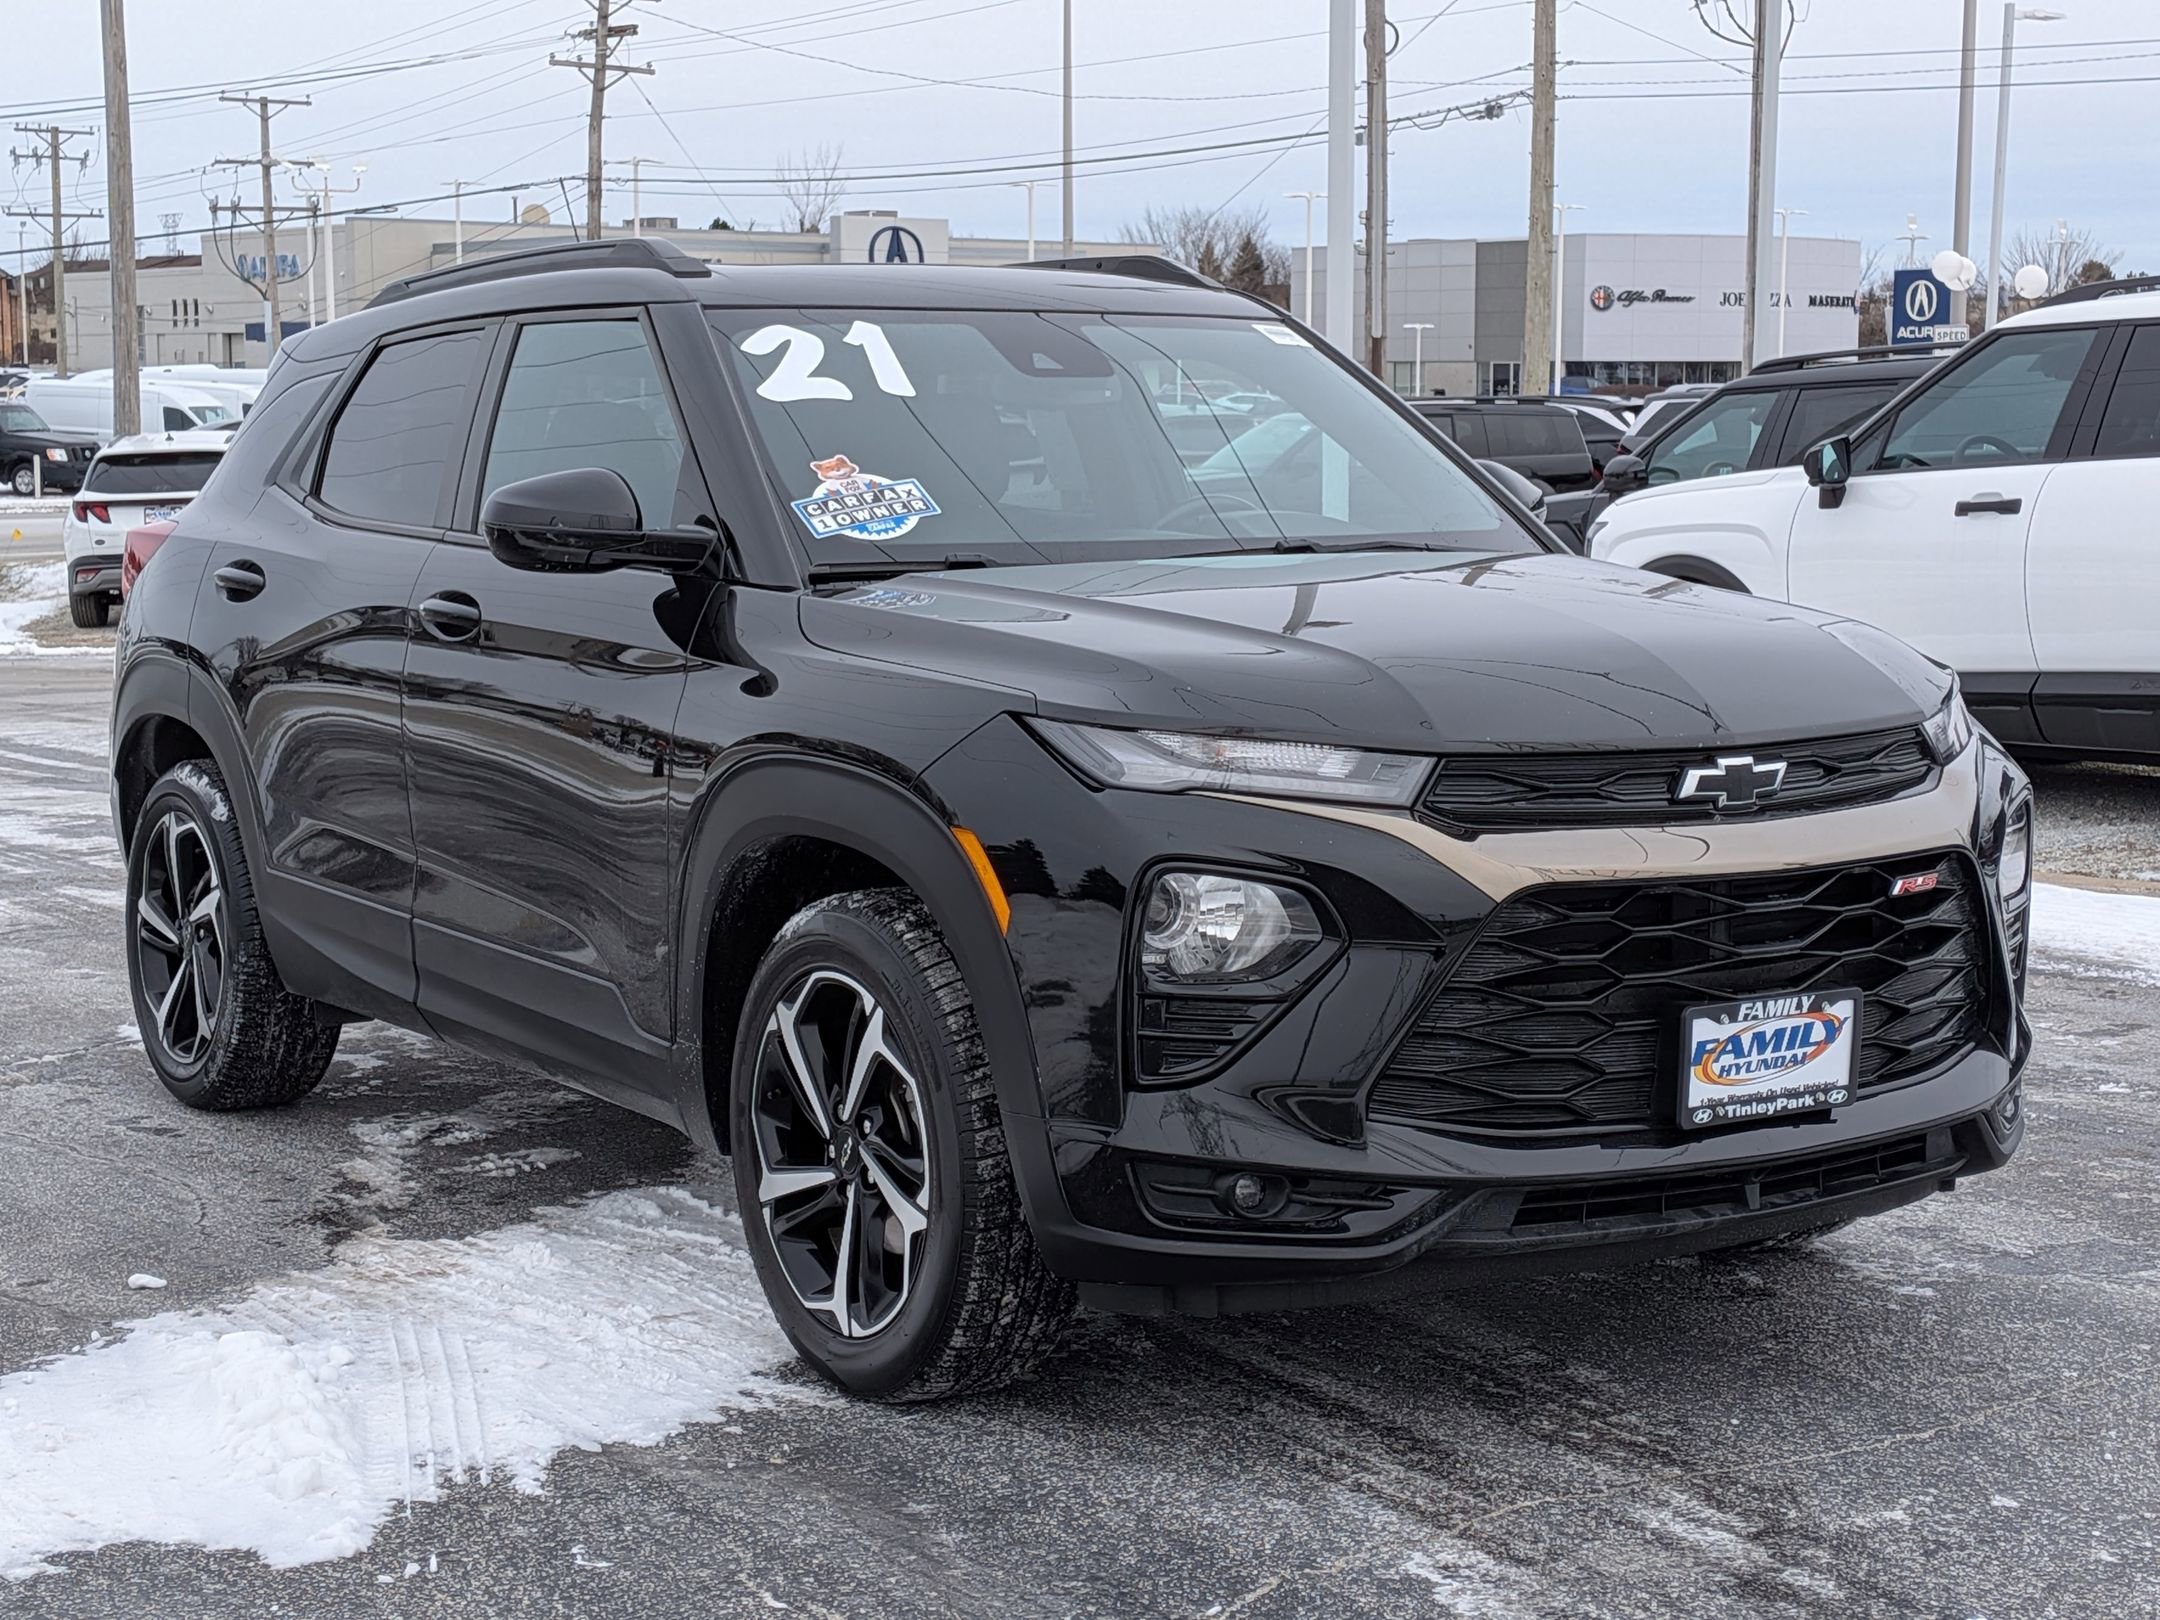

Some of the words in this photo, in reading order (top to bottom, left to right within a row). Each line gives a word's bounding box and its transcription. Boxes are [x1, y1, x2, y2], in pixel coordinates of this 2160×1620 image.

[1616, 290, 1650, 308] Alfa
[1650, 289, 1696, 303] Romeo
[1719, 292, 1746, 307] JOE
[1896, 325, 1934, 339] ACUR
[1936, 331, 1966, 341] SPEED
[740, 319, 916, 402] 21
[839, 479, 859, 488] CAR
[807, 487, 917, 516] CARFAX
[818, 519, 832, 530] 1
[835, 498, 928, 526] OWNER
[1737, 995, 1816, 1023] FAMILY
[1691, 1016, 1852, 1067] FAMILY
[1718, 1051, 1808, 1079] HYUNDAI
